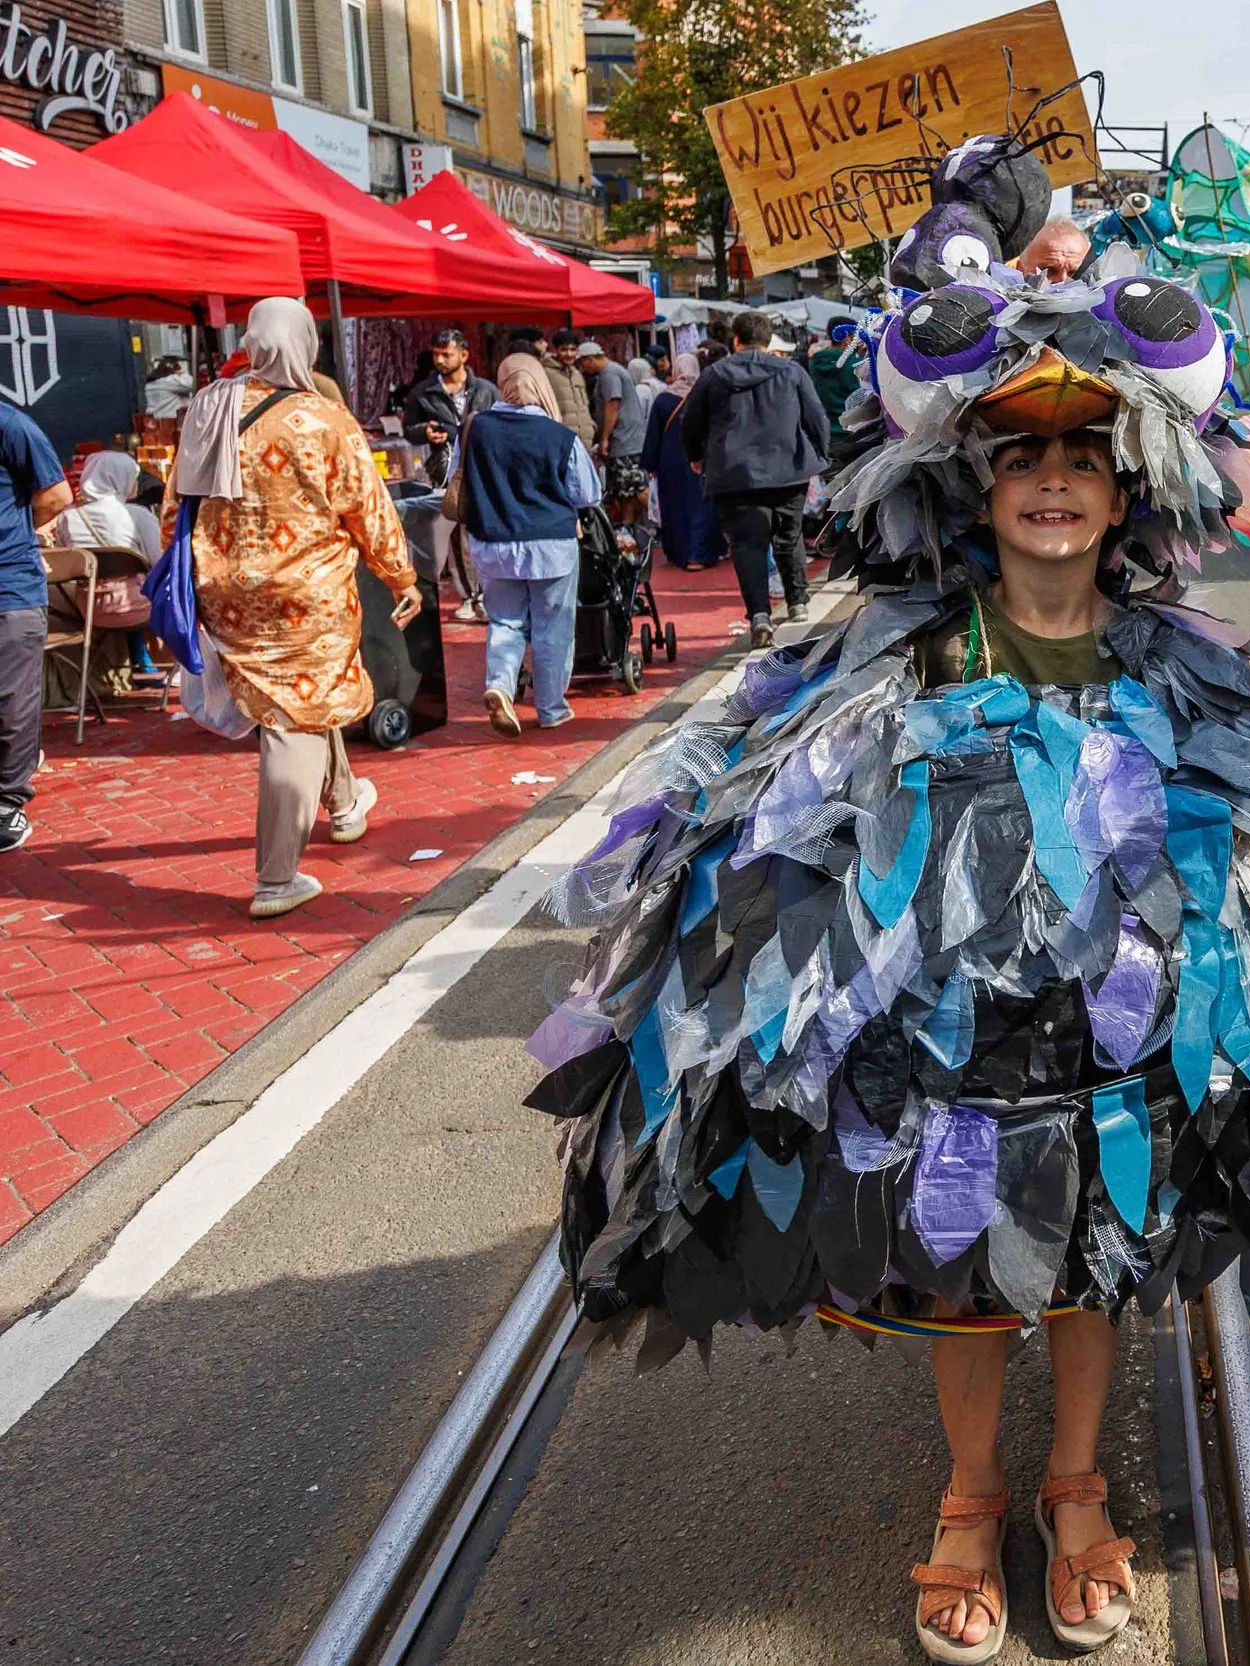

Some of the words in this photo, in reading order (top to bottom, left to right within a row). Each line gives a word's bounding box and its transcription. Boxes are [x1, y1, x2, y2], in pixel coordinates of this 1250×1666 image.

[717, 95, 796, 181] Wij
[789, 64, 961, 151] kiezen
[492, 179, 561, 232] WOODS
